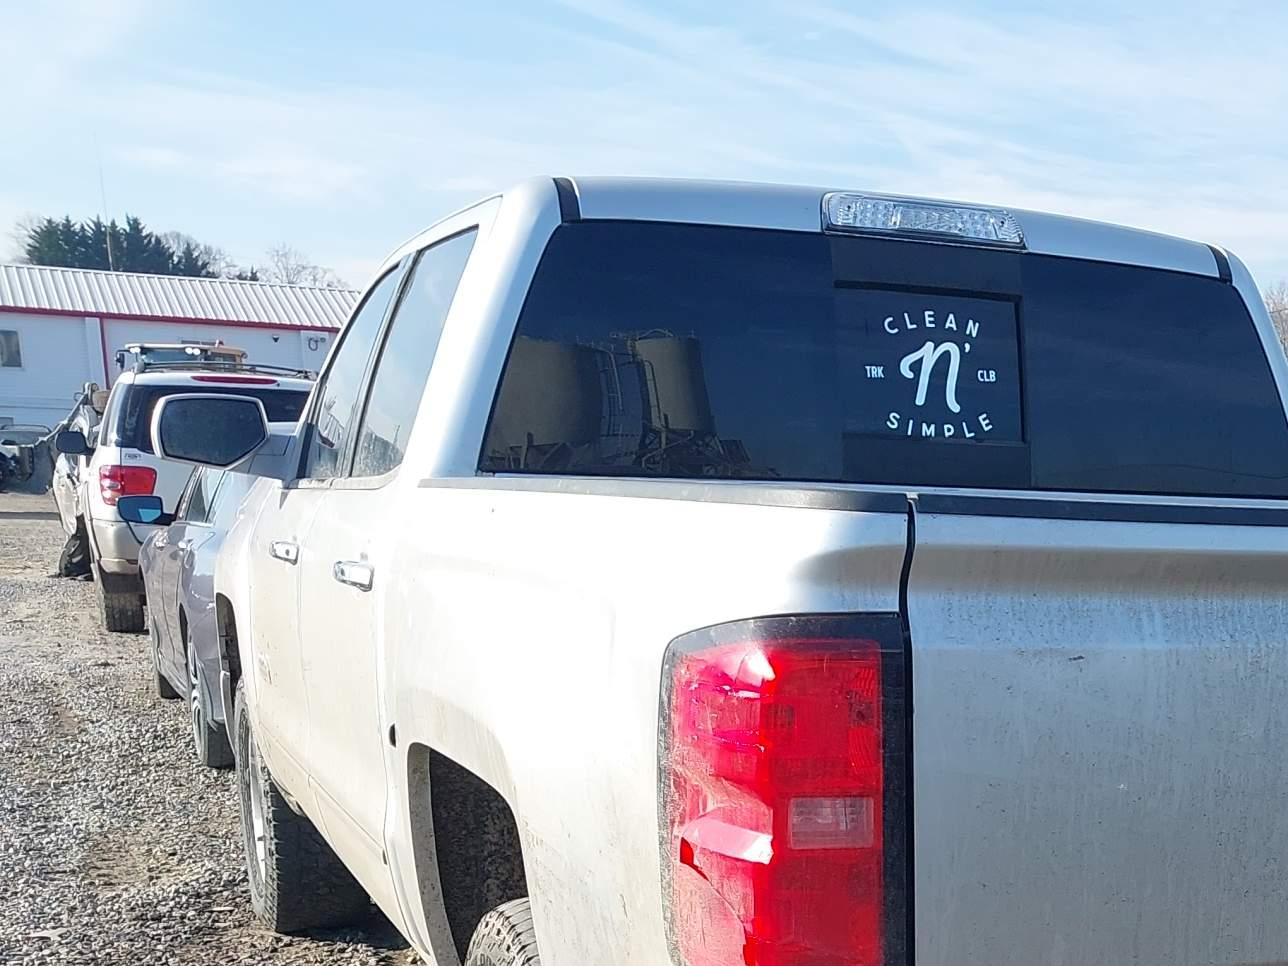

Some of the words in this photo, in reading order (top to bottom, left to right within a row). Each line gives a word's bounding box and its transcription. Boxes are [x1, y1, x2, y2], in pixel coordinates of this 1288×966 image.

[883, 310, 980, 338] CLEAN
[865, 365, 885, 379] TRK
[977, 370, 997, 382] CLB
[886, 412, 993, 439] SIMPLE
